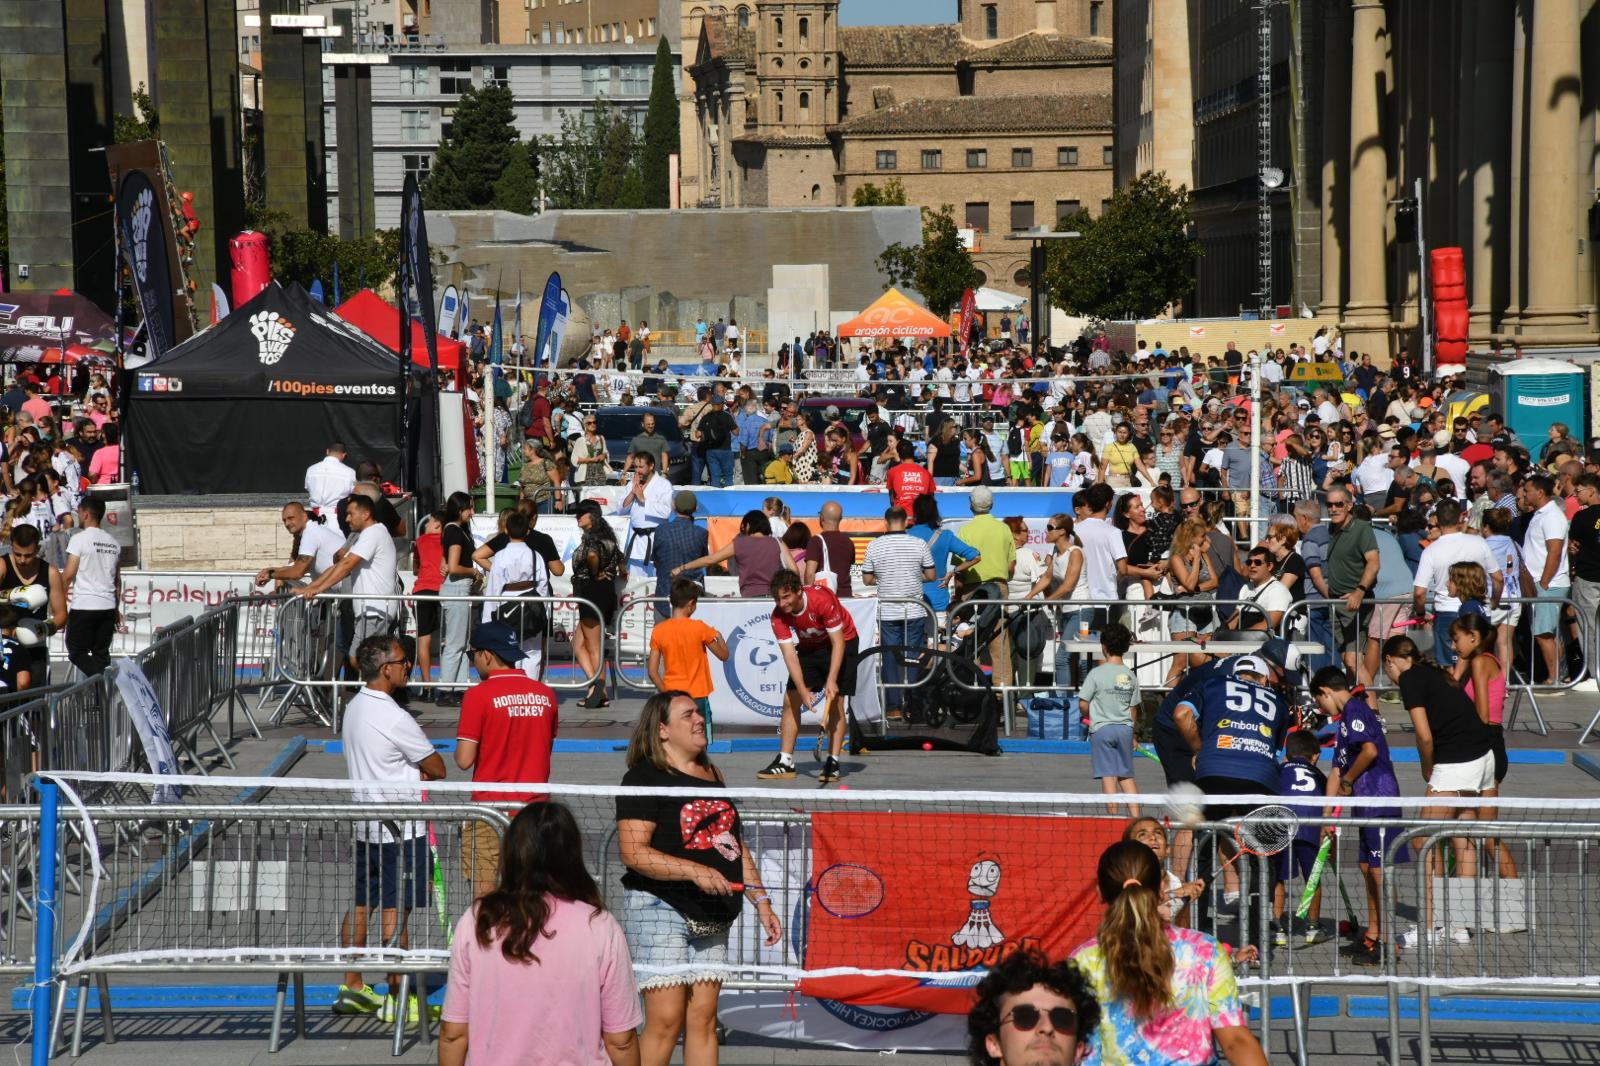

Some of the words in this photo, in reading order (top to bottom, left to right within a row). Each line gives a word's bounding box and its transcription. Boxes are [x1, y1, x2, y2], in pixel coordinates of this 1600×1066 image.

[855, 325, 889, 336] aragón
[892, 327, 934, 335] ciclismo
[1403, 366, 1410, 379] 9
[268, 380, 396, 396] /100pieseventos
[759, 683, 777, 692] EST
[493, 692, 552, 708] HONIGVÖGEL
[735, 687, 774, 715] ZARAGOZA
[1225, 681, 1277, 721] 55
[507, 705, 544, 717] HOCKEY
[1217, 718, 1259, 732] embou
[1231, 743, 1242, 751] DE
[1232, 736, 1270, 751] GOBIERNO
[1290, 767, 1317, 792] 5
